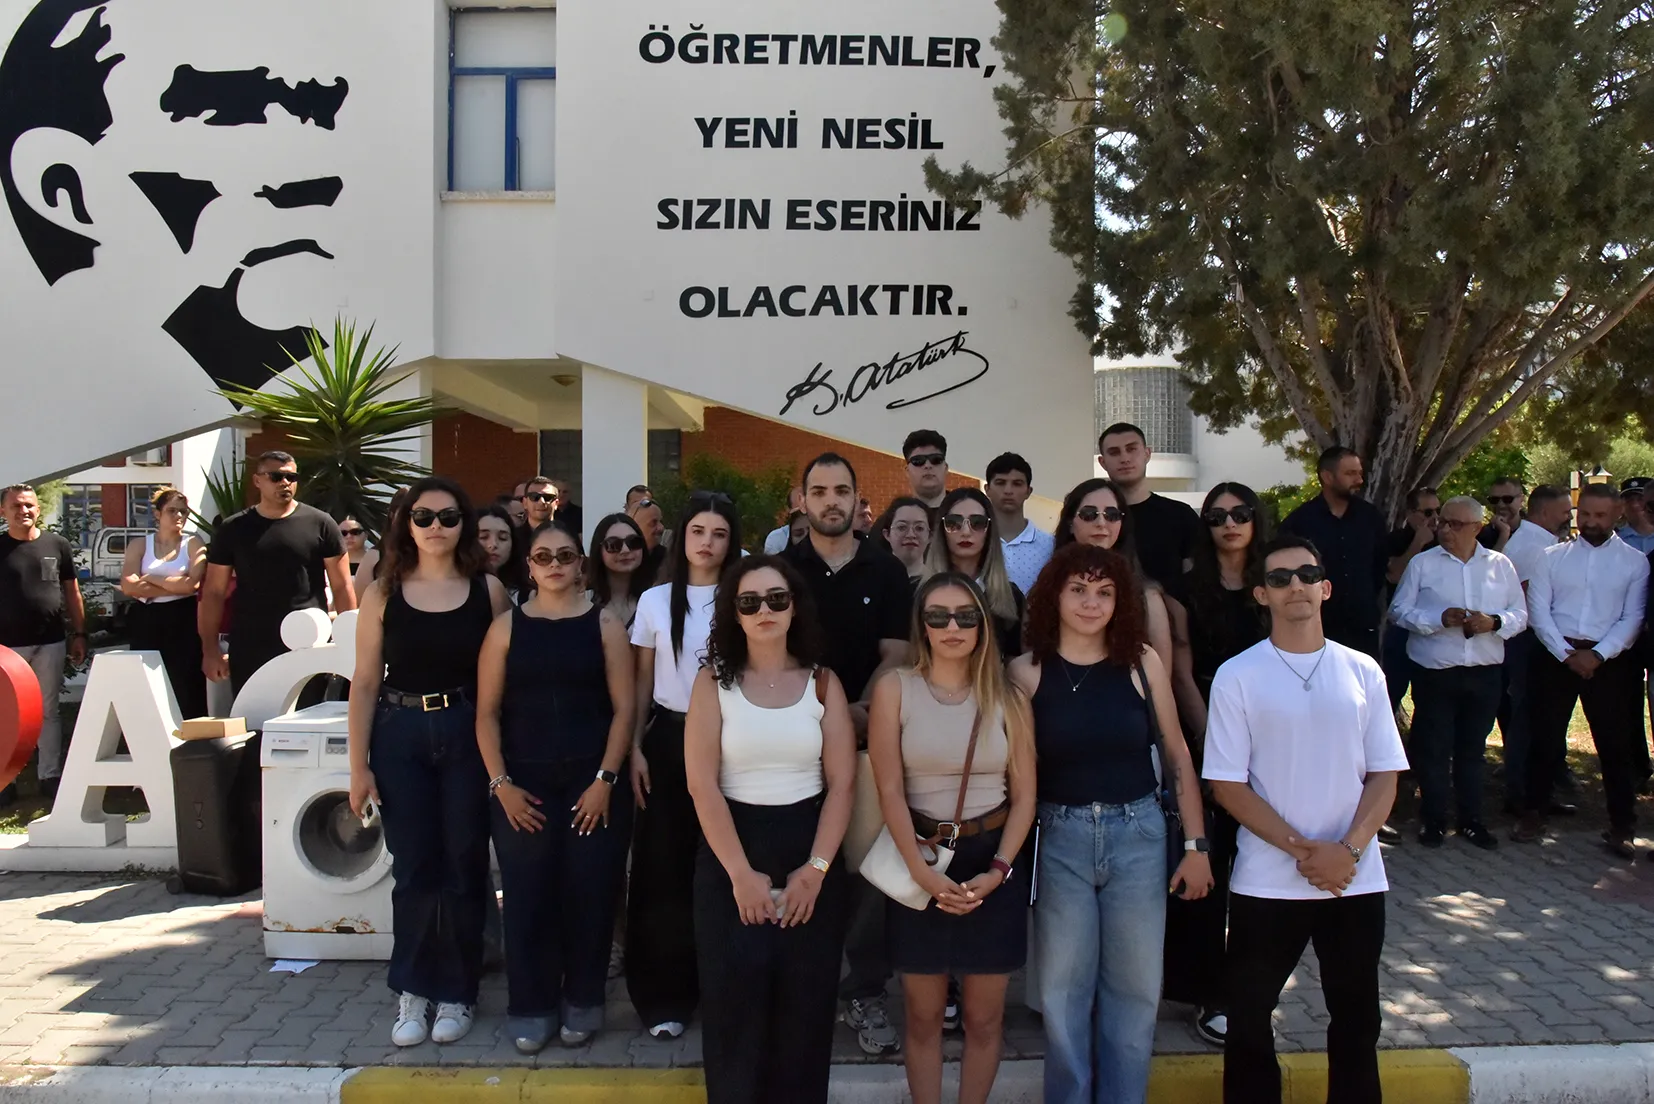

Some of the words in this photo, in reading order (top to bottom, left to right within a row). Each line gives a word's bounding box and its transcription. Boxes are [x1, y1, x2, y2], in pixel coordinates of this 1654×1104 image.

[639, 23, 997, 78] ÖĞRETMENLER,
[695, 110, 798, 148] YENİ
[821, 111, 944, 149] NESİL
[656, 198, 771, 230] SIZIN
[679, 284, 968, 318] OLACAKTIR.
